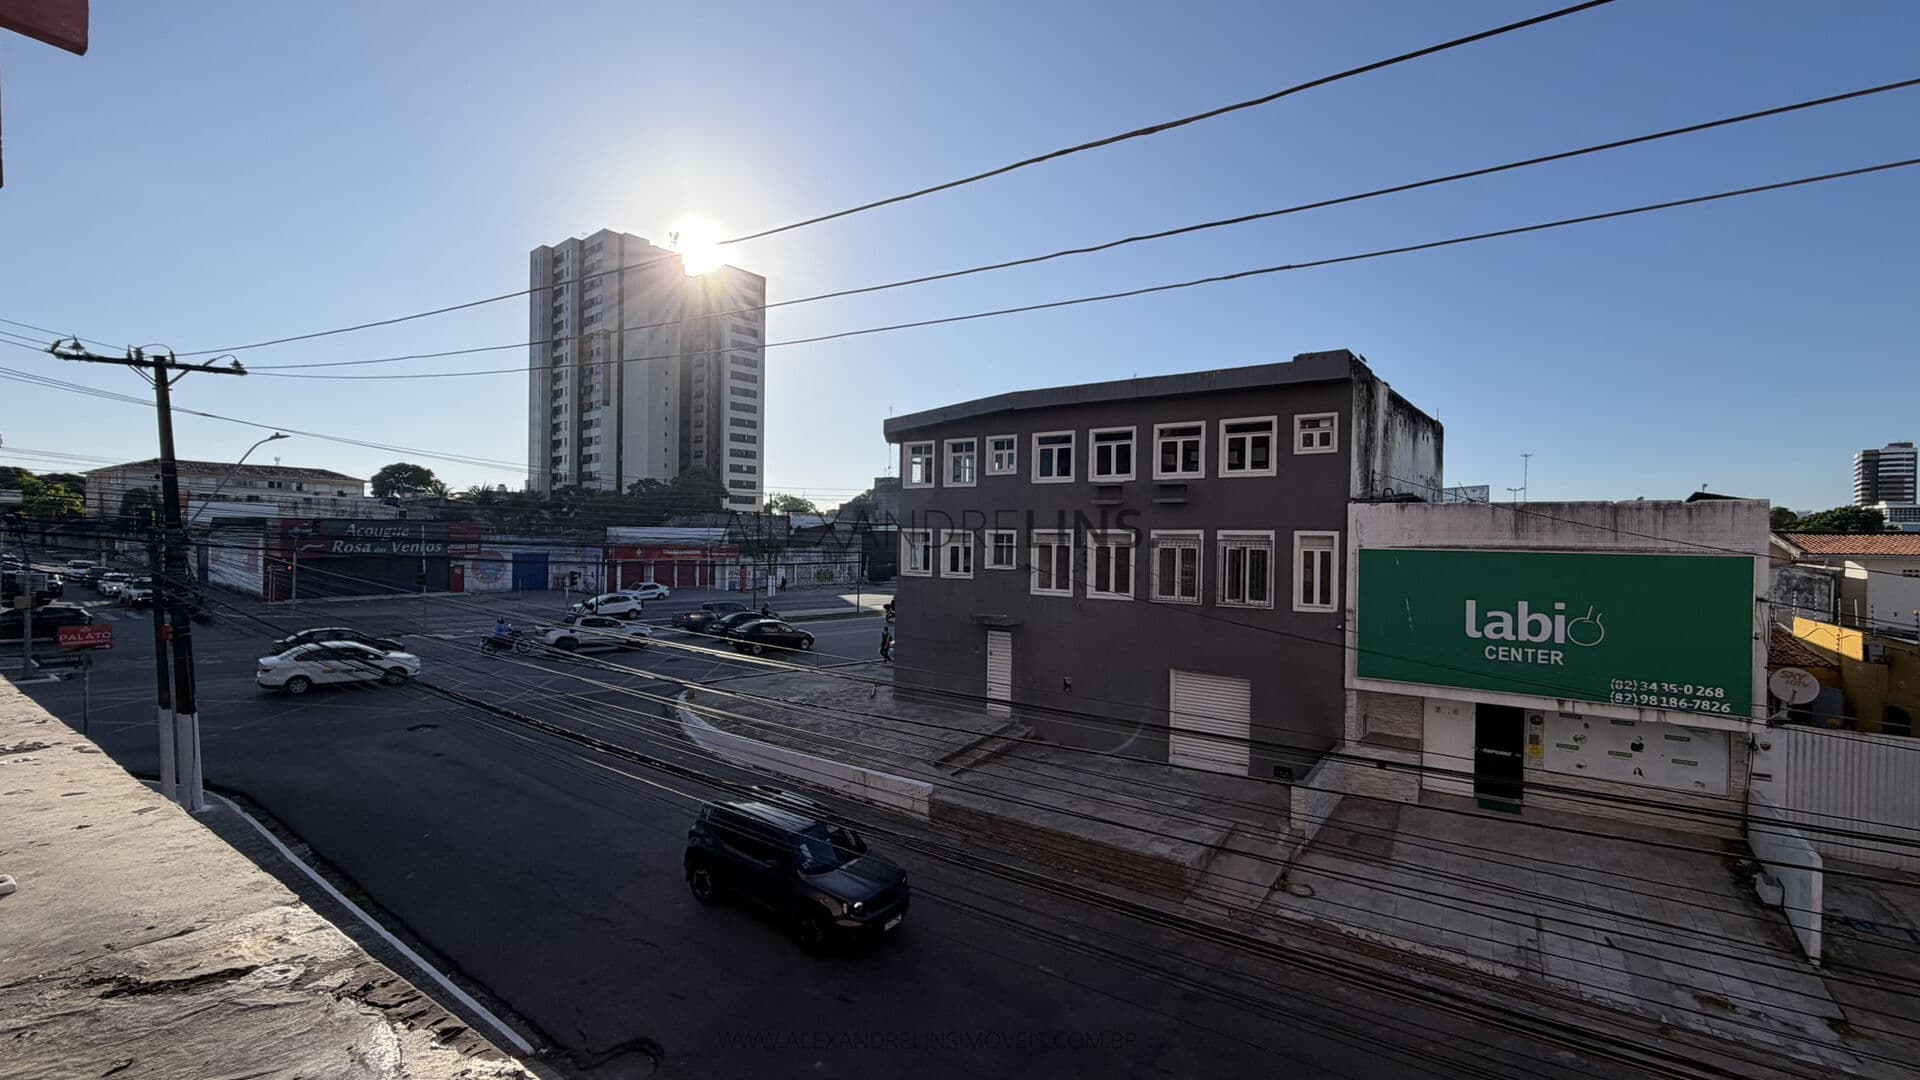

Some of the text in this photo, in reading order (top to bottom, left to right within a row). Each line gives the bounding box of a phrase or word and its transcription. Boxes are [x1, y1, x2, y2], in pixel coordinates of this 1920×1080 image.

[332, 540, 371, 553] Rosa
[393, 541, 442, 553] Ventos
[59, 632, 112, 642] PALATO
[1484, 645, 1564, 666] CENTER
